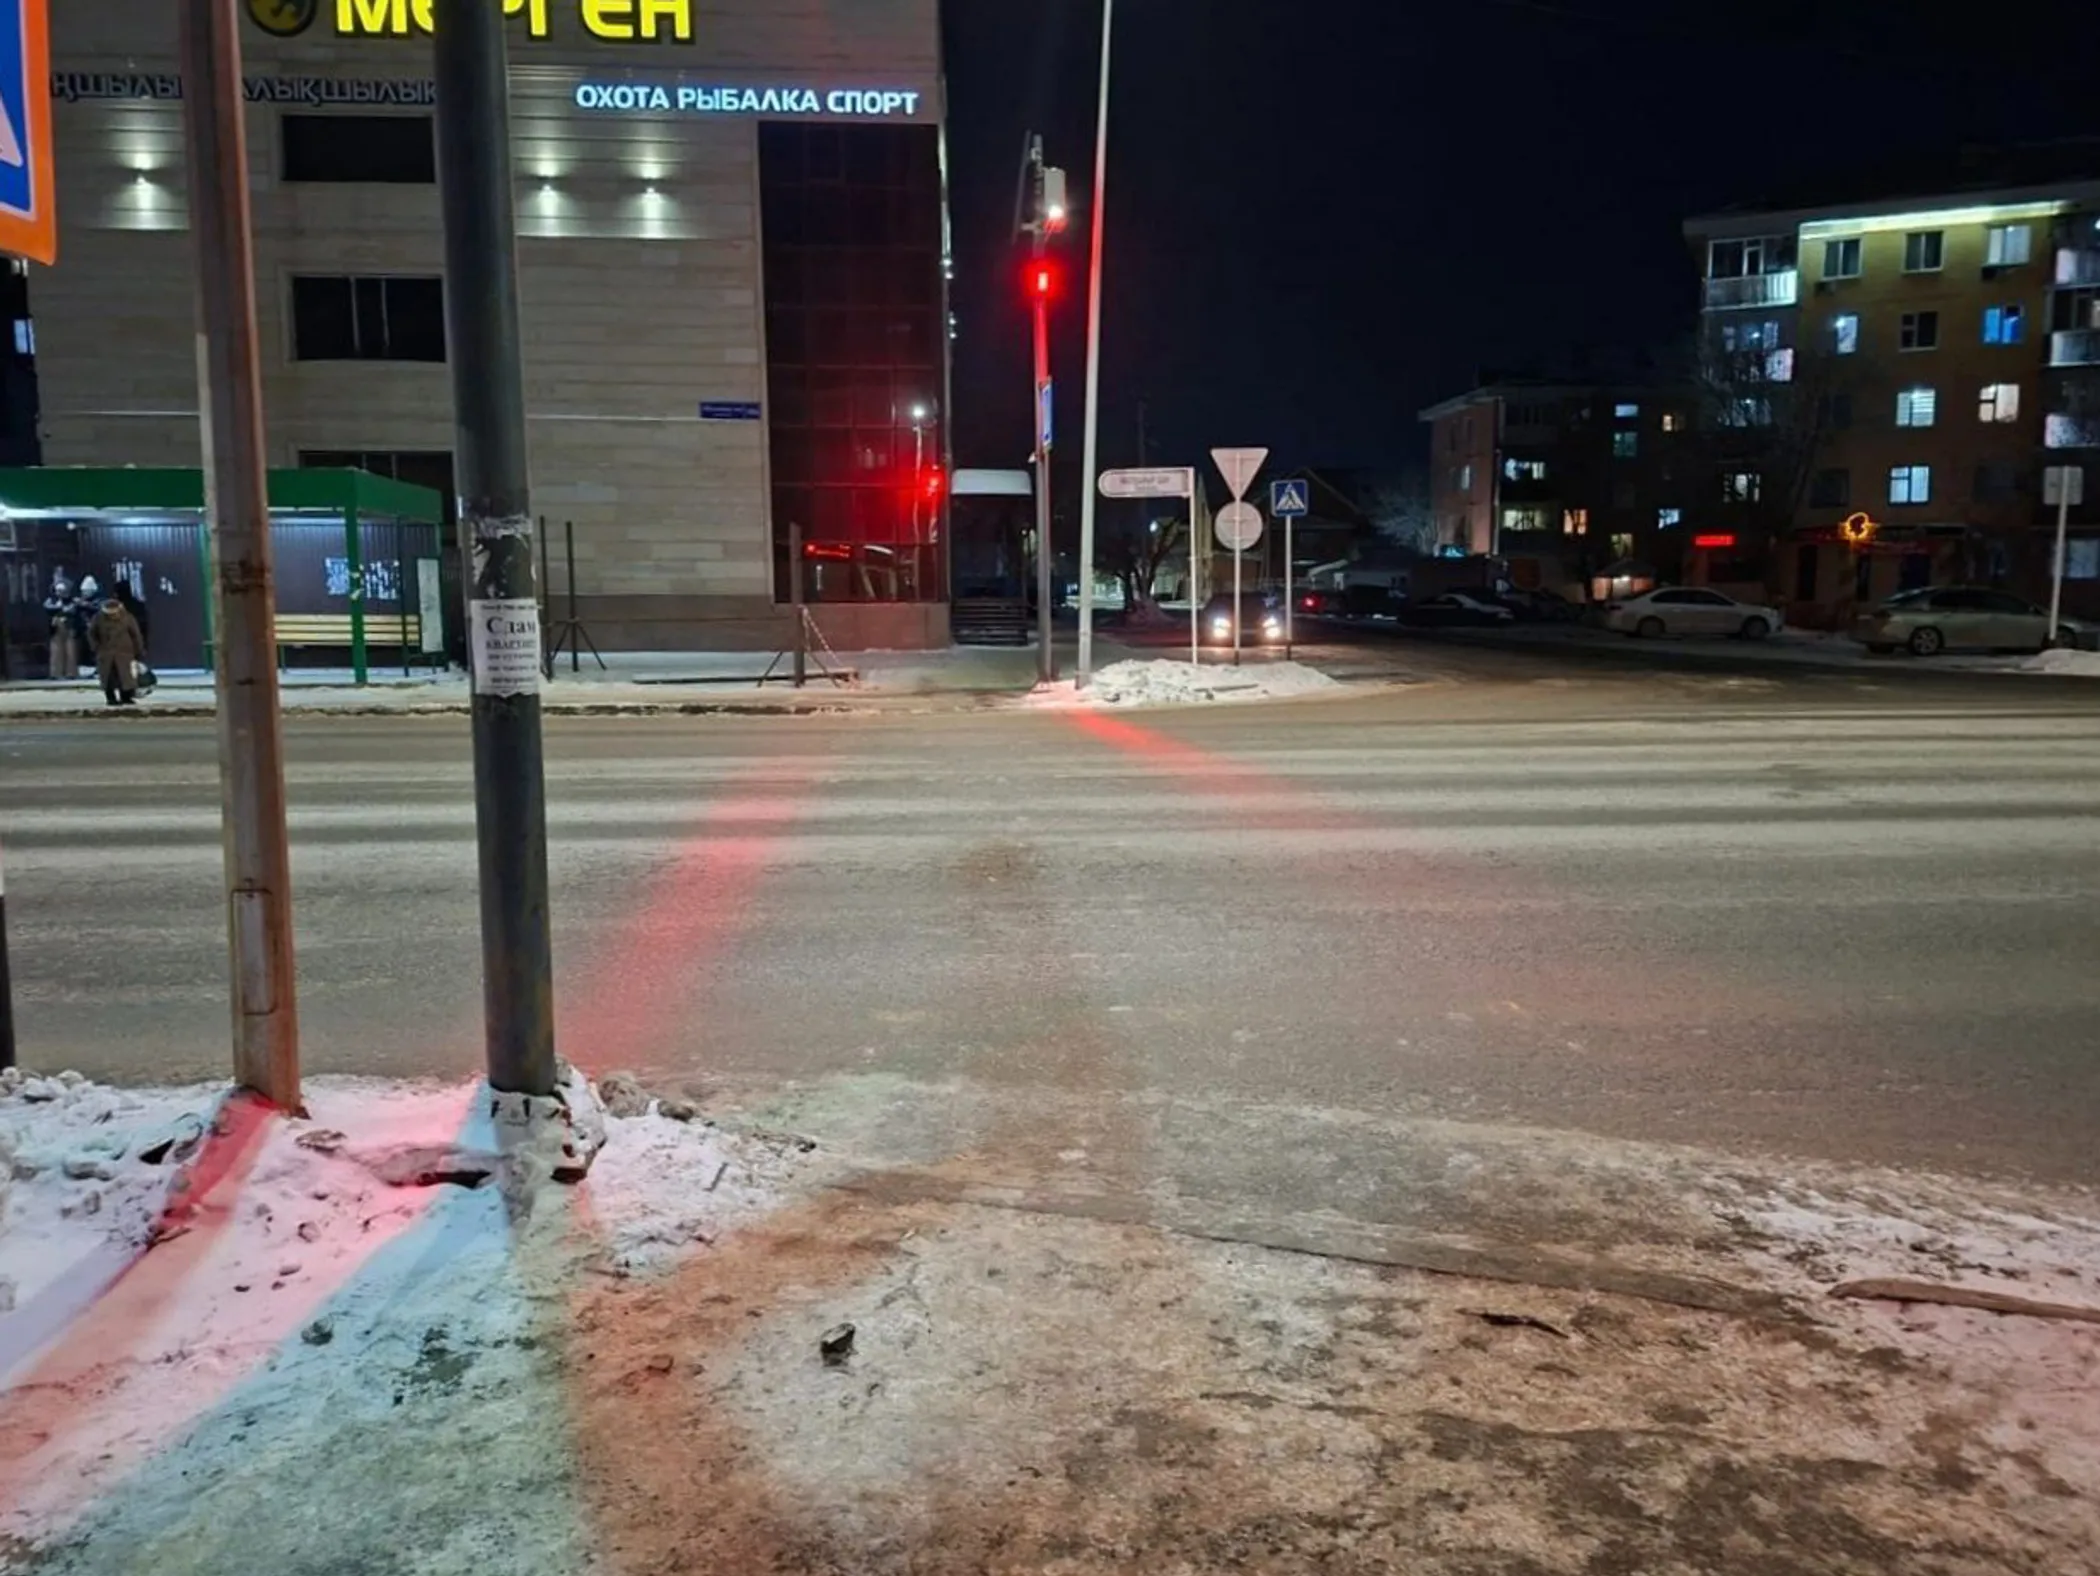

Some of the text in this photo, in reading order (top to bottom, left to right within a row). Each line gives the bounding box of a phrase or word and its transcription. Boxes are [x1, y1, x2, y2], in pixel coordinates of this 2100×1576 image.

[337, 0, 691, 39] МЕН
[53, 73, 437, 104] ҢШЫЛЫ ЛЫҚШЫЛЫ
[576, 85, 919, 115] ОХОТА РЫБАЛКА СПОРТ
